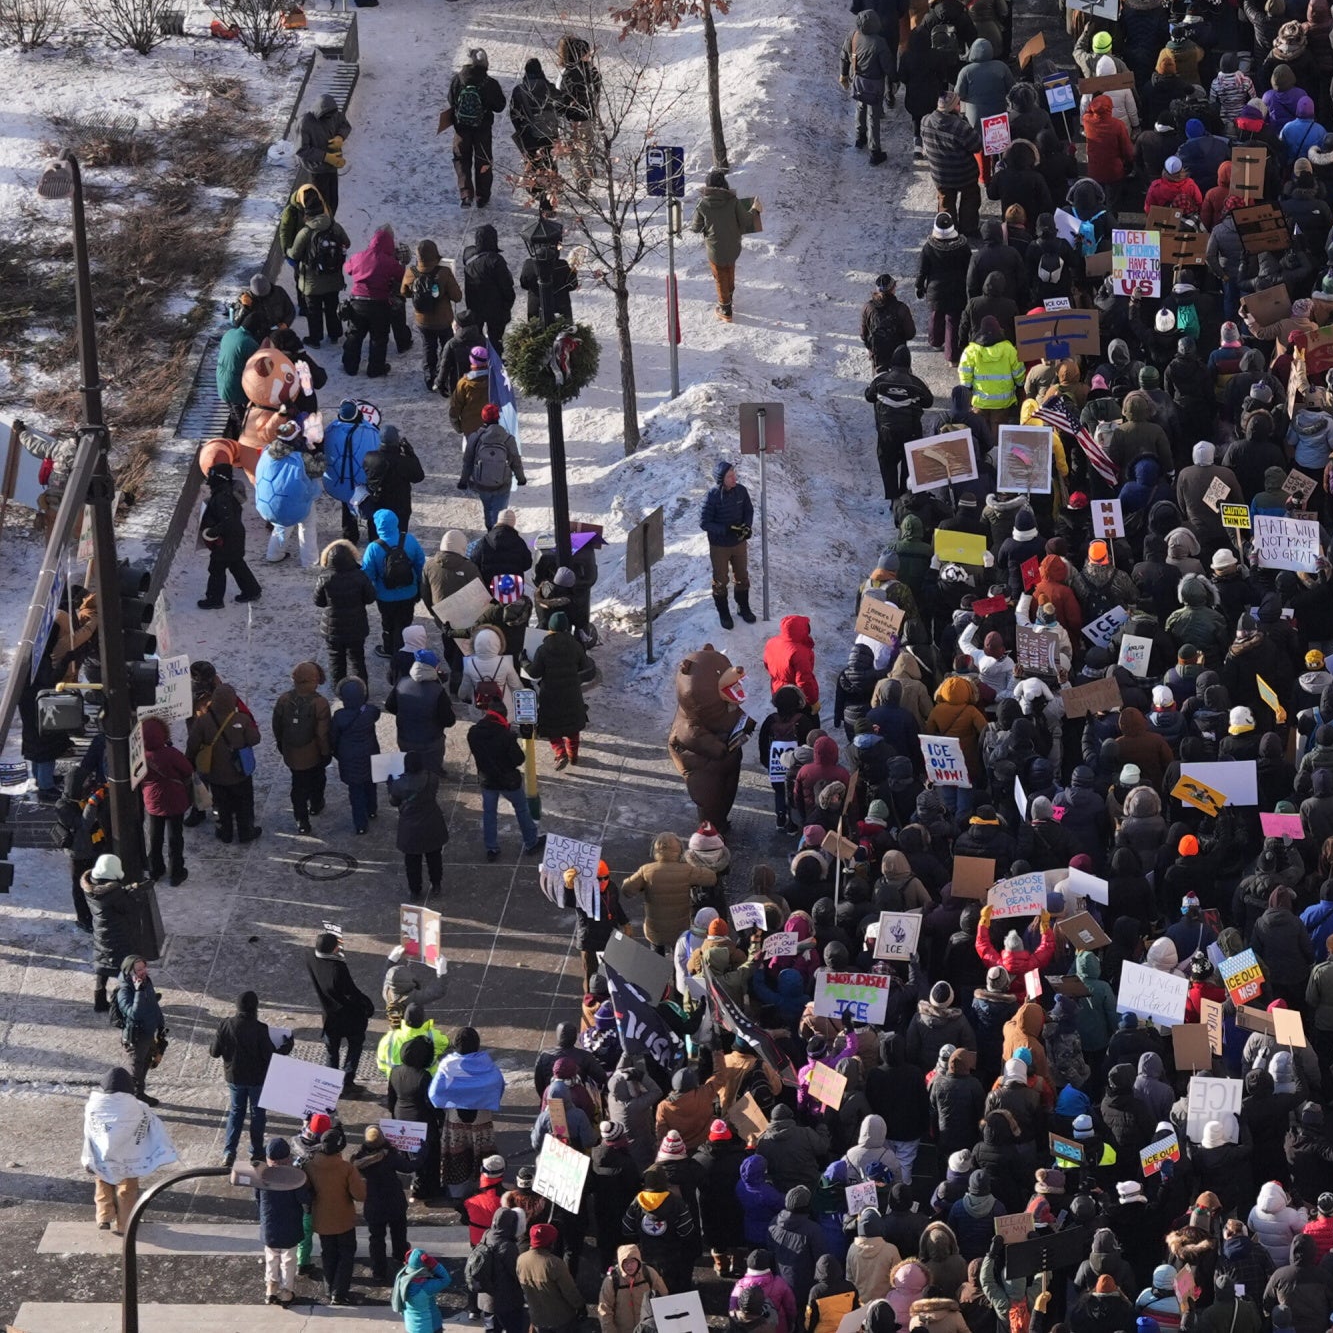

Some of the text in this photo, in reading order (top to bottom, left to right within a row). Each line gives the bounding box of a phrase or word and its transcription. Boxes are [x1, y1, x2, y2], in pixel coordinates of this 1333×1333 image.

[1114, 231, 1144, 244] TO GET
[1128, 258, 1160, 270] HAVE TO
[1121, 279, 1153, 295] US
[1223, 505, 1248, 516] CAUTION
[1224, 517, 1249, 527] THIN ICE
[1258, 519, 1317, 539] HATE WILL
[1261, 536, 1313, 549] NOT MAKE
[1259, 547, 1312, 564] US GREAT
[1089, 615, 1120, 638] ICE
[928, 743, 952, 757] ICE
[931, 757, 956, 769] OUT
[935, 768, 963, 781] NOW!
[547, 834, 596, 857] JUSTICE
[547, 849, 594, 867] RENEE
[1003, 874, 1042, 890] CHOOSE
[1006, 895, 1033, 905] BEAR
[885, 945, 902, 954] ICE
[1225, 965, 1261, 989] ICE OUT
[824, 984, 878, 1004] MELTS
[1237, 982, 1258, 1000] MSP
[833, 1000, 870, 1020] ICE
[1207, 1004, 1218, 1034] FUCK
[1144, 1145, 1176, 1165] ICE OUT
